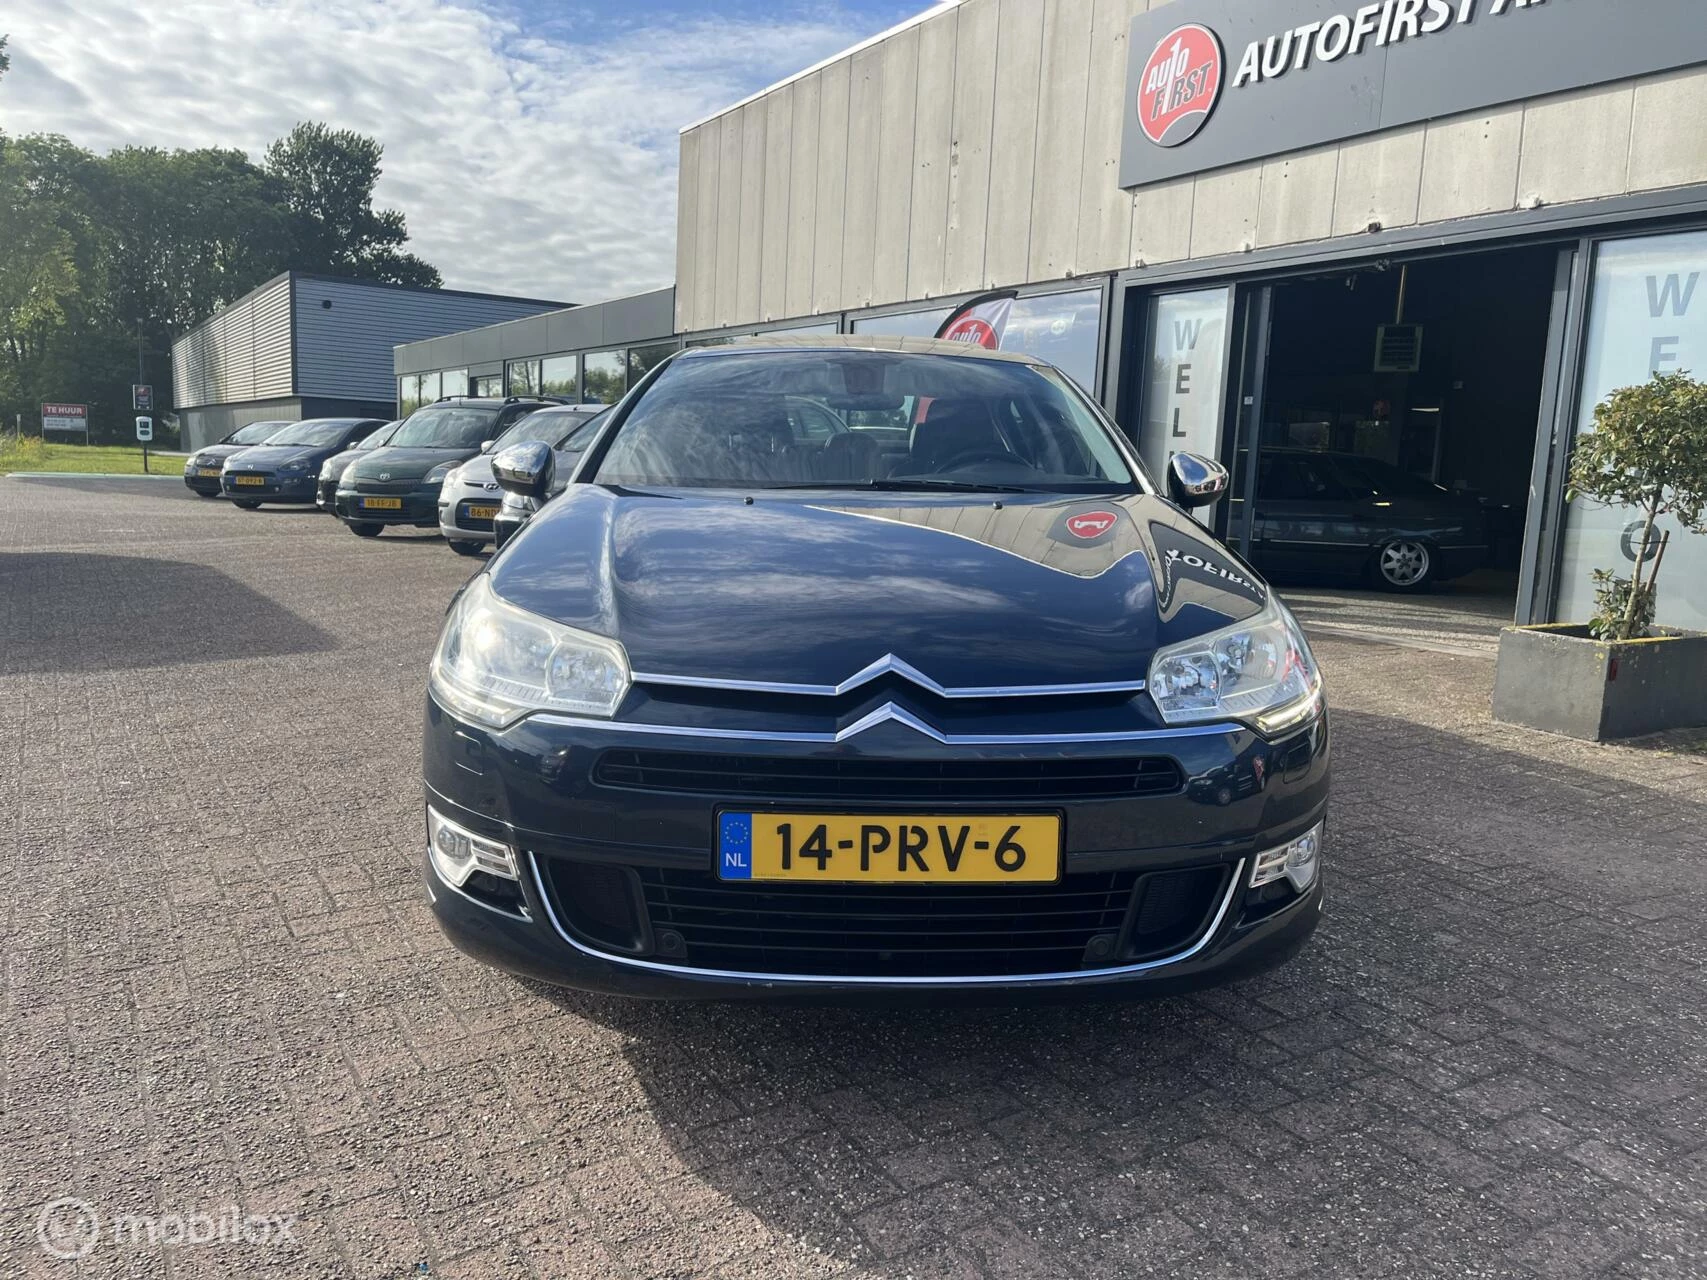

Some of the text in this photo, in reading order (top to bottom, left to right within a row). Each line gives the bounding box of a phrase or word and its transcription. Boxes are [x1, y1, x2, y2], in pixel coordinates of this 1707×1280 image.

[58, 406, 82, 414] HUUR
[776, 823, 1026, 873] 14-PRV-6
[725, 853, 747, 867] NL
